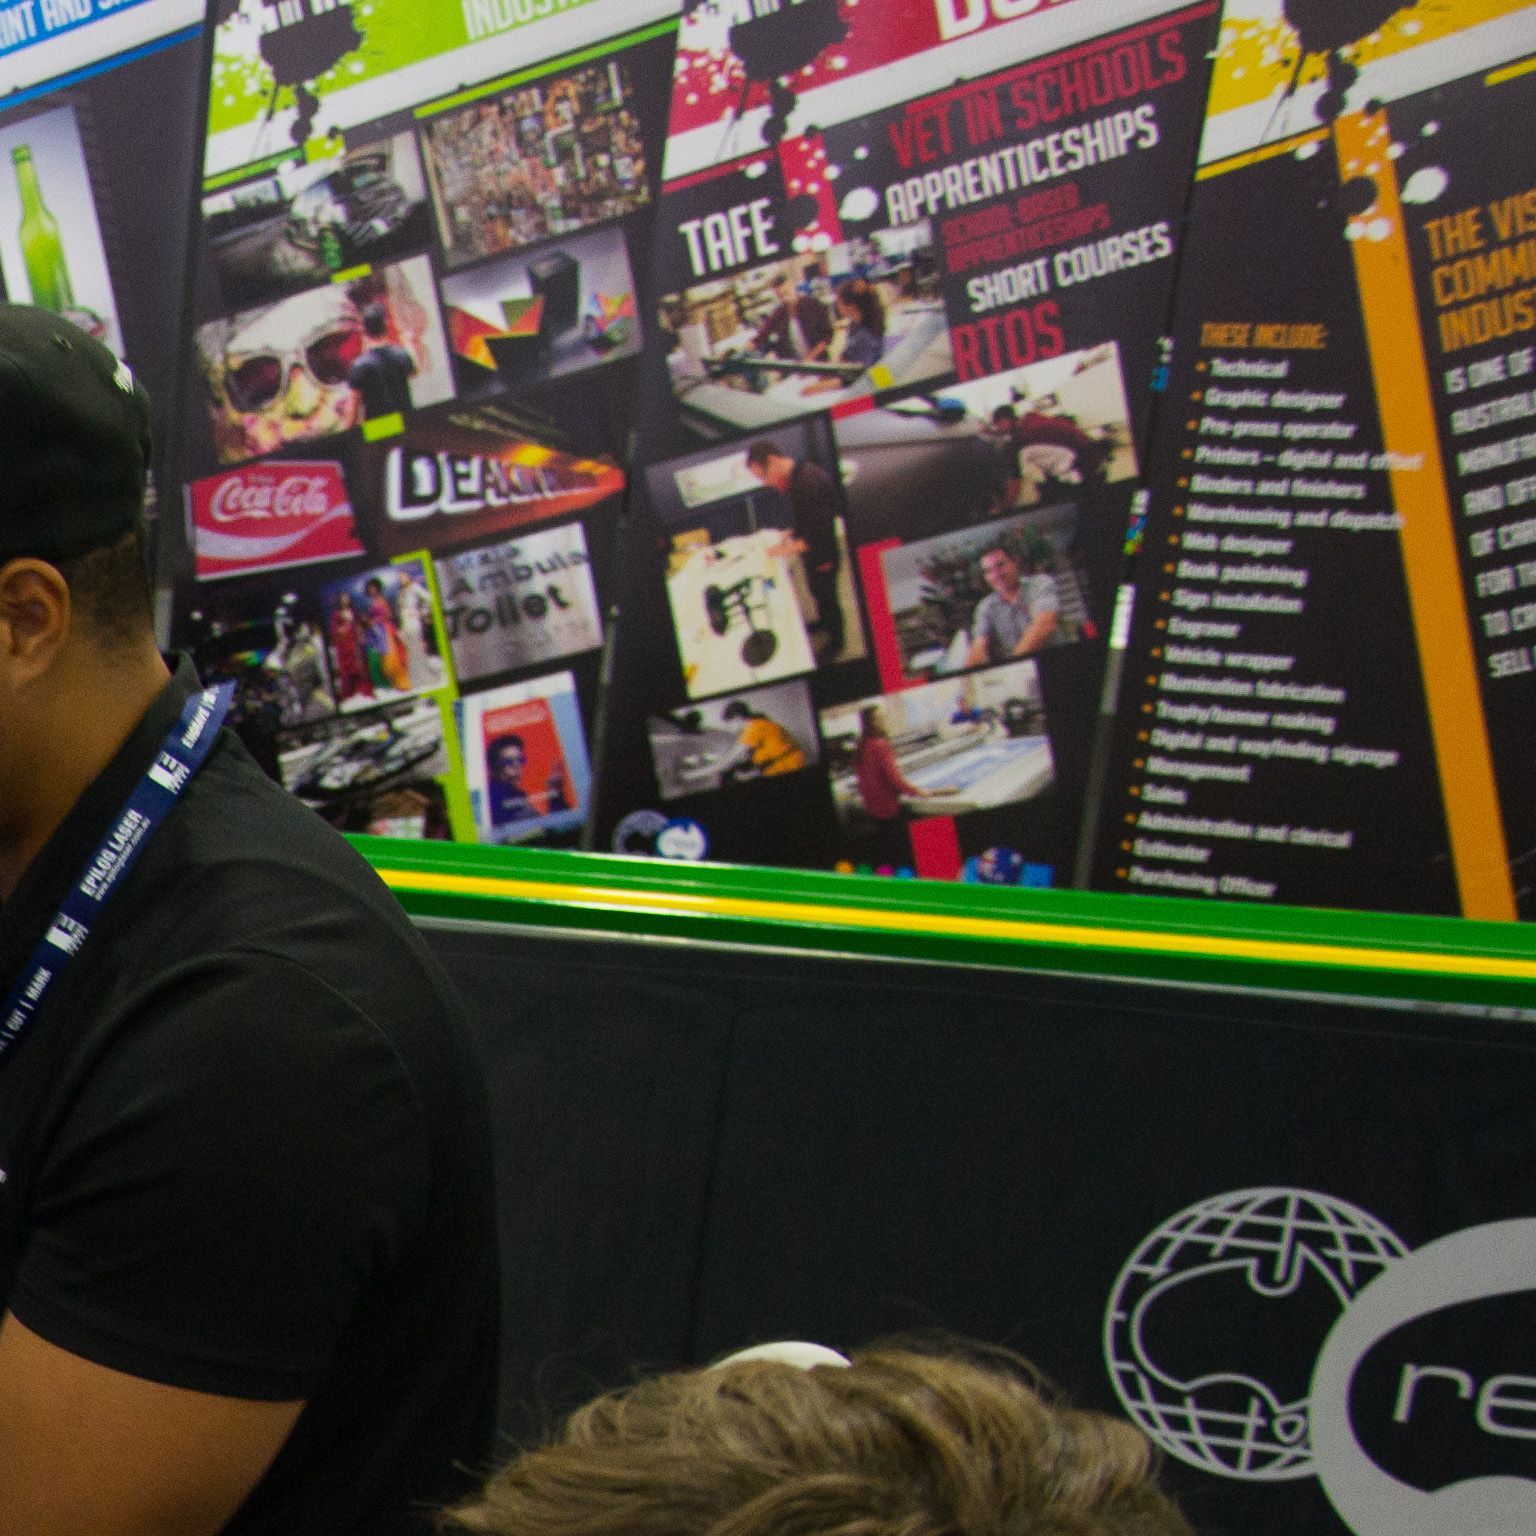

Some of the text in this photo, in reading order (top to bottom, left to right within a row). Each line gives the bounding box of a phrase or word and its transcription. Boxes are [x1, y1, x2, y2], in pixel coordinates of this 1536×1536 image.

[887, 30, 1187, 170] VET IN SCHOOLS
[885, 103, 1161, 226] APPRENTICESHIPS
[678, 198, 780, 277] TAFE
[1423, 205, 1487, 261] THE
[965, 221, 1174, 314] SHORT COURSES
[1432, 238, 1536, 306] COMM
[950, 300, 1066, 383] RTOS
[1205, 386, 1347, 412] Graphic designer
[1443, 364, 1466, 396] IS
[1194, 446, 1261, 466] Printers
[1277, 448, 1333, 471] digital
[1333, 451, 1369, 470] and
[1255, 477, 1290, 497] and
[1220, 535, 1294, 557] designer
[1293, 508, 1328, 528] and
[1150, 728, 1204, 752] Digital
[1204, 736, 1238, 754] and
[79, 808, 144, 897] EPILOG LASER
[1255, 824, 1289, 844] and
[5, 1008, 28, 1033] CUT
[24, 966, 54, 1002] MARK
